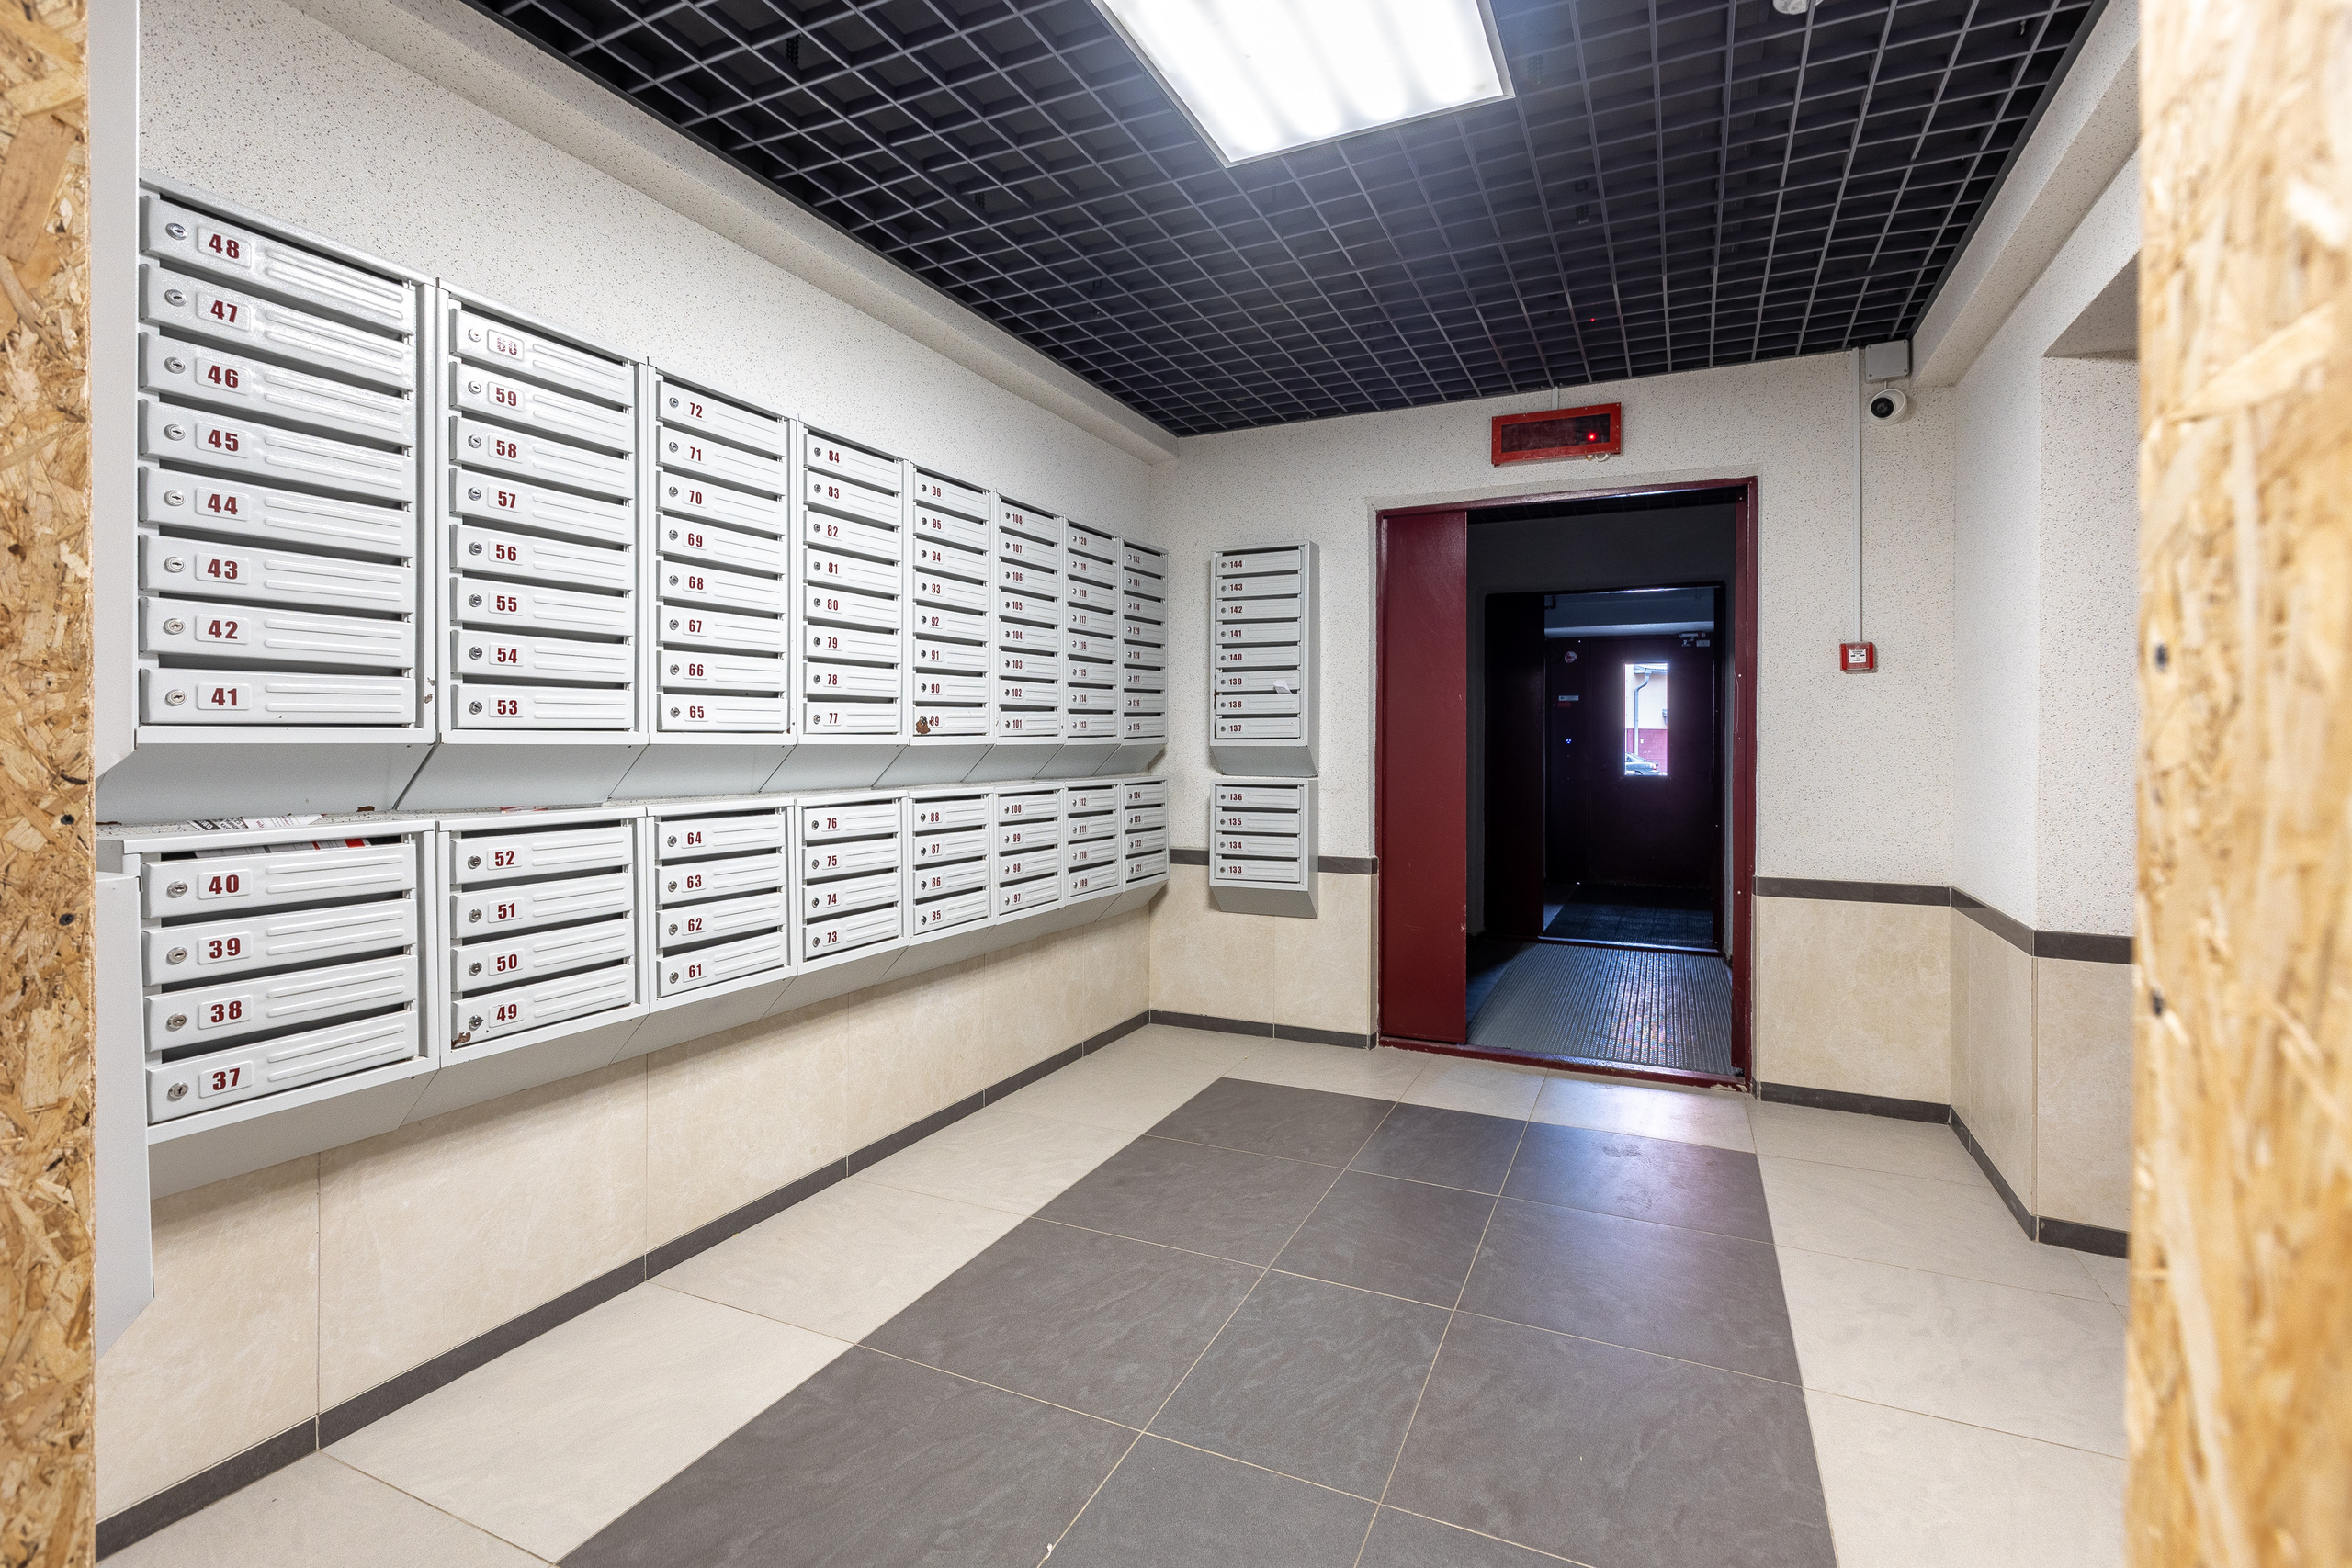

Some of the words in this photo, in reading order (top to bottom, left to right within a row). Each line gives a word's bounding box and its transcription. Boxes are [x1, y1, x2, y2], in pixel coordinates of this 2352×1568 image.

[209, 234, 239, 259] 48
[211, 300, 237, 322] 47
[208, 366, 238, 388] 46
[496, 388, 516, 406] 59
[690, 402, 702, 418] 72
[209, 430, 238, 451] 45
[496, 440, 516, 458] 58
[690, 446, 701, 461] 71
[829, 450, 839, 463] 84
[689, 491, 702, 504] 70
[829, 486, 839, 499] 83
[933, 486, 941, 497] 96
[208, 494, 238, 514] 44
[498, 491, 515, 508] 57
[933, 519, 941, 529] 95
[1012, 514, 1023, 525] 108
[828, 525, 838, 537] 82
[688, 533, 702, 547] 69
[496, 545, 516, 561] 56
[1013, 544, 1022, 553] 107
[933, 551, 941, 562] 94
[208, 559, 237, 580] 43
[829, 562, 838, 574] 81
[1012, 572, 1023, 581] 106
[689, 576, 703, 590] 68
[932, 583, 940, 594] 93
[497, 596, 516, 612] 55
[828, 599, 838, 610] 80
[1012, 601, 1022, 610] 105
[689, 620, 702, 632] 67
[932, 616, 939, 626] 92
[209, 620, 238, 639] 42
[1012, 631, 1023, 639] 104
[828, 637, 837, 649] 79
[498, 648, 517, 663] 54
[932, 650, 939, 660] 91
[689, 664, 703, 676] 66
[1012, 660, 1022, 669] 103
[828, 674, 837, 685] 78
[932, 683, 940, 694] 90
[1012, 688, 1022, 697] 102
[211, 688, 237, 705] 41
[498, 700, 517, 715] 53
[690, 706, 704, 718] 65
[830, 713, 838, 723] 77
[930, 716, 939, 727] 89
[1013, 719, 1022, 728] 101
[1012, 805, 1021, 813] 100
[931, 812, 939, 822] 88
[827, 818, 837, 829] 76
[687, 832, 701, 845] 64
[1013, 833, 1021, 842] 99
[932, 844, 939, 854] 87
[495, 851, 514, 866] 52
[828, 855, 837, 866] 75
[1013, 863, 1021, 873] 98
[209, 874, 239, 894] 40
[687, 875, 701, 888] 63
[932, 877, 940, 887] 86
[828, 894, 837, 905] 74
[1014, 893, 1021, 903] 97
[498, 903, 514, 919] 51
[933, 910, 941, 921] 85
[688, 918, 702, 931] 62
[828, 931, 837, 943] 73
[209, 938, 240, 959] 39
[497, 954, 517, 971] 50
[689, 964, 701, 977] 61
[211, 1001, 242, 1022] 38
[497, 1004, 516, 1021] 49
[213, 1068, 240, 1090] 37
